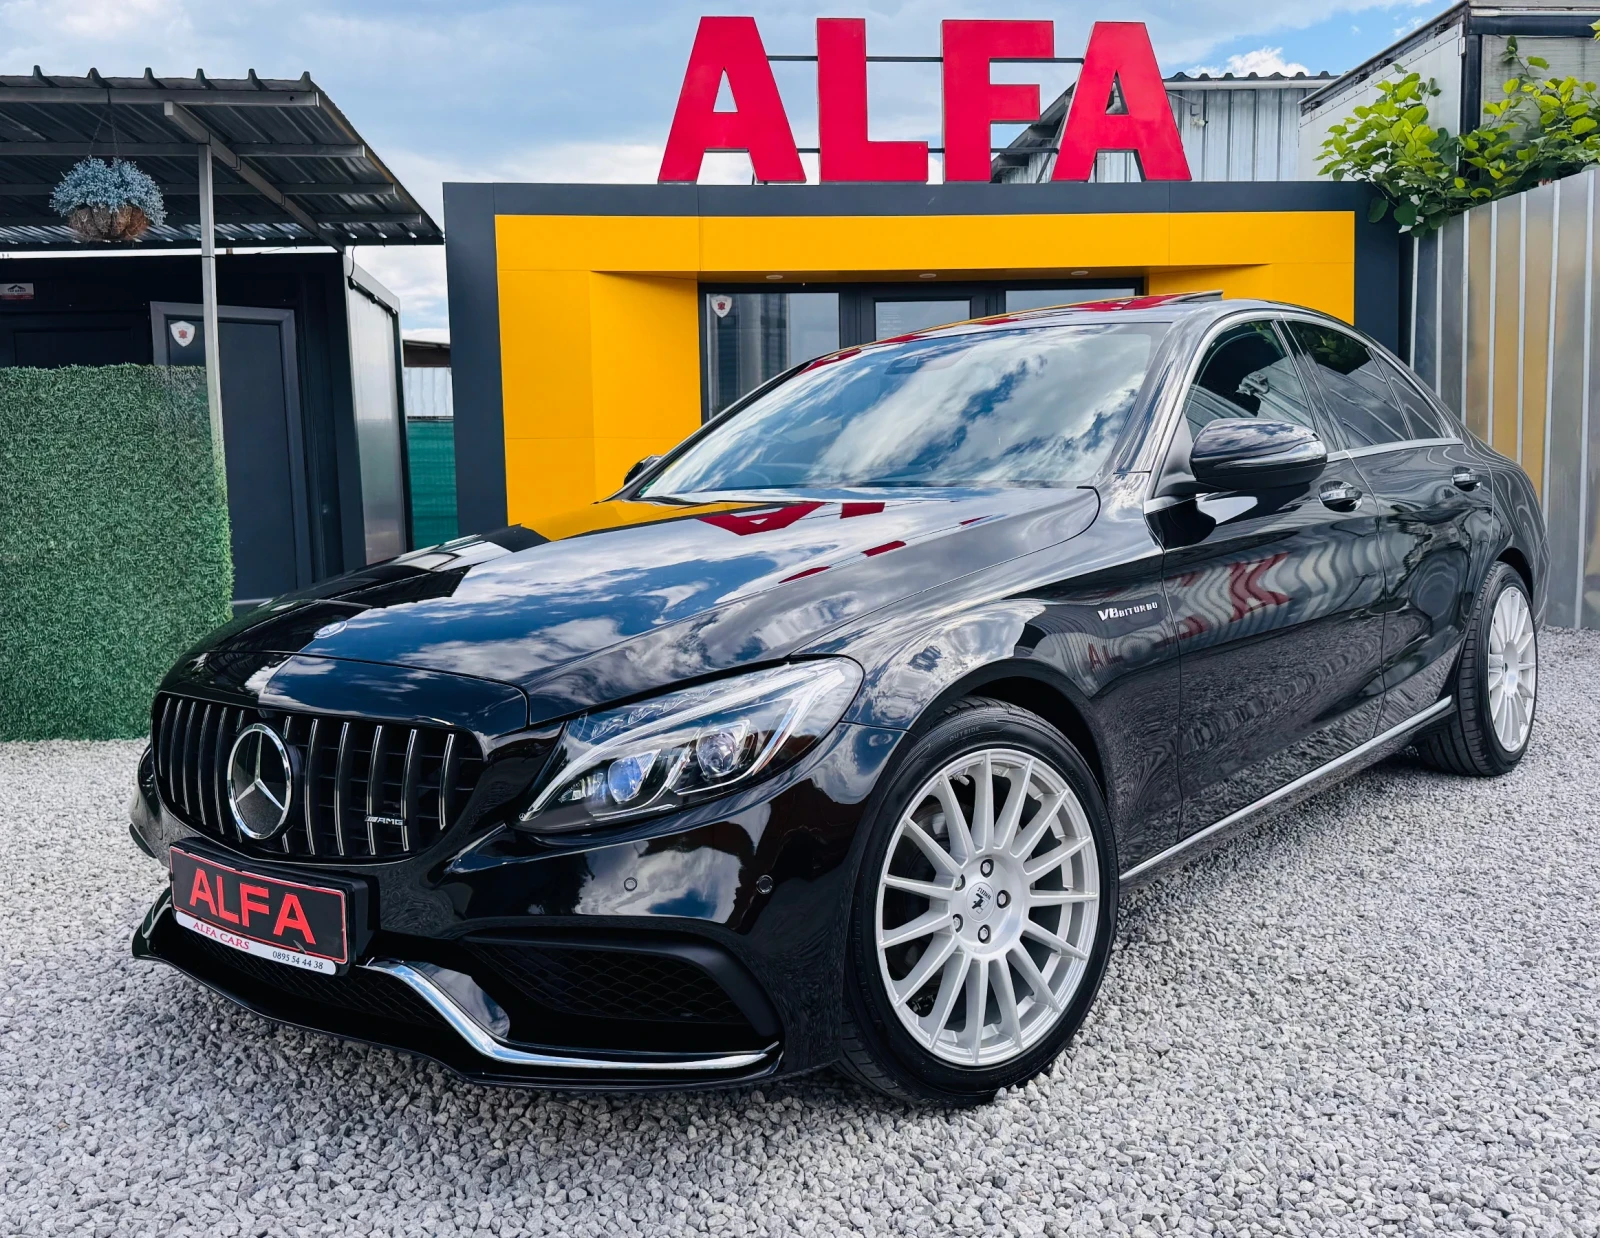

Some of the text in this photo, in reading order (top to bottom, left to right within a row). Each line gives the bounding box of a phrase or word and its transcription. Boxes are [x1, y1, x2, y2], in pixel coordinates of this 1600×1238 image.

[657, 16, 1193, 183] ALFA
[376, 816, 404, 826] AMG
[189, 868, 317, 945] ALFA
[193, 922, 250, 950] ALFA CARS
[272, 950, 324, 970] 0895 54 44 38
